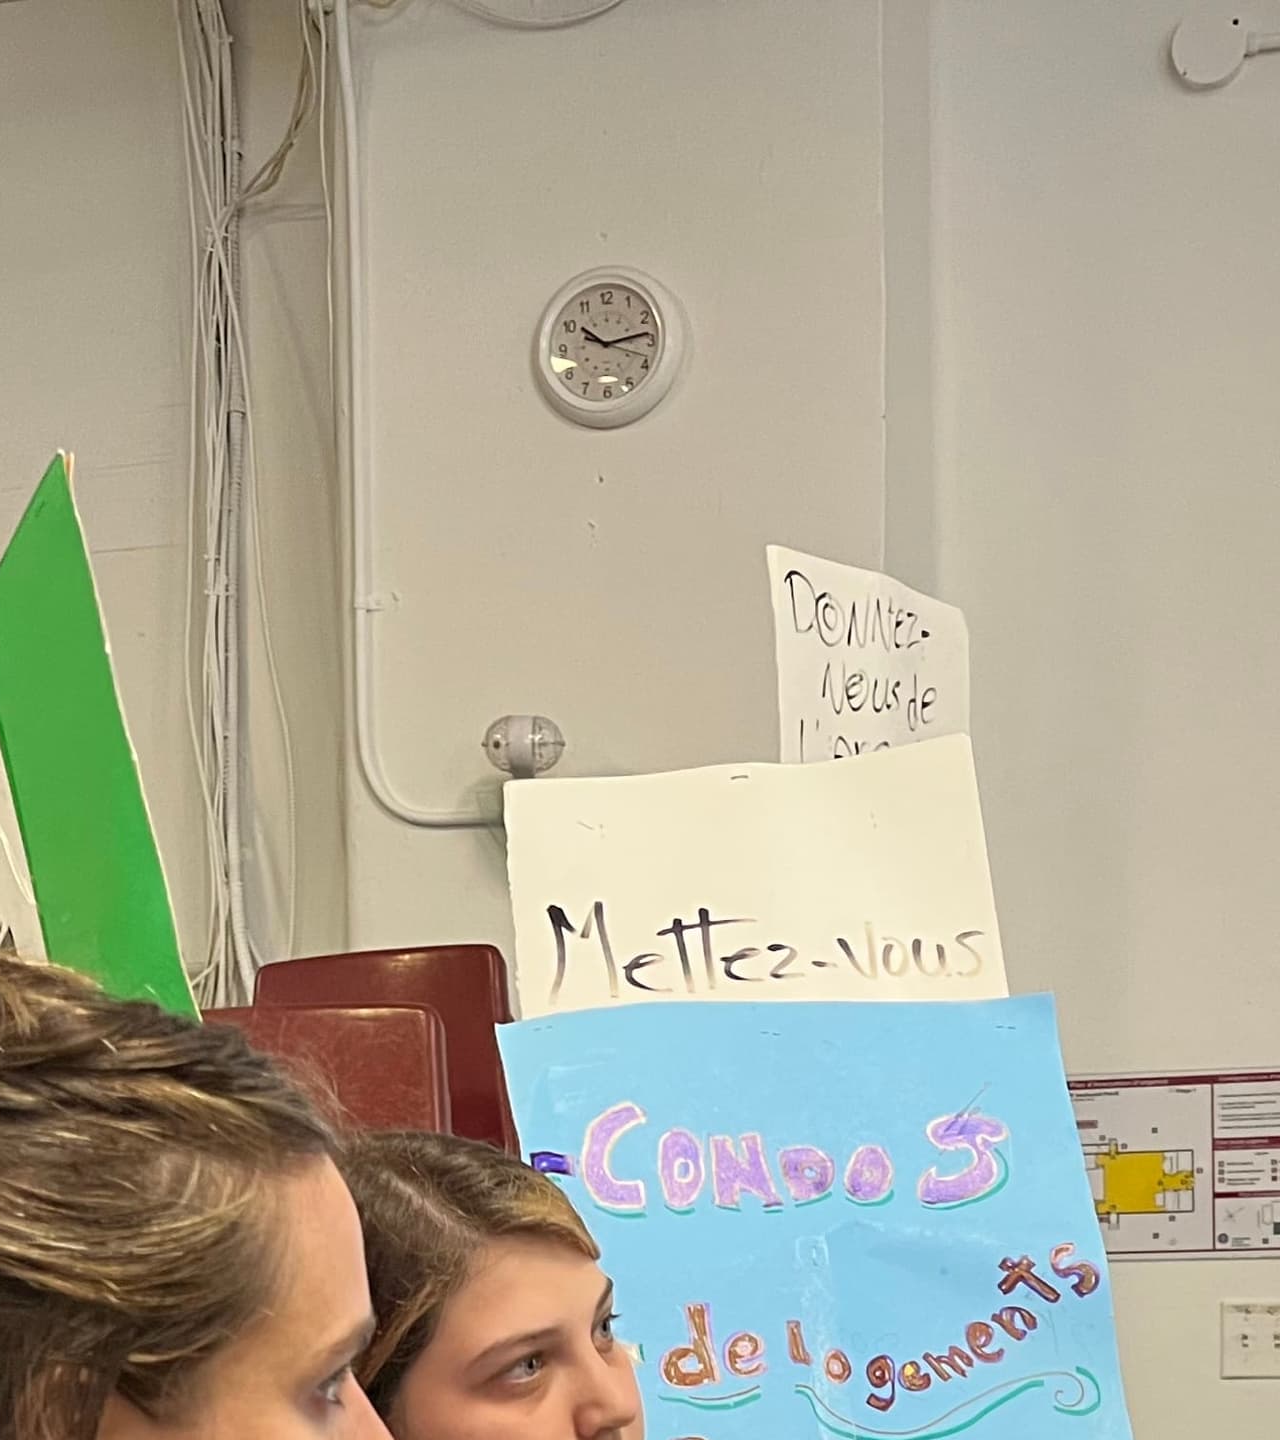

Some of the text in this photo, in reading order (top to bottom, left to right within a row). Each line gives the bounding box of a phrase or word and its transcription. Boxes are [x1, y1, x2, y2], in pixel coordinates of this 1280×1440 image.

[599, 290, 614, 305] 12
[625, 295, 632, 309] 1
[579, 300, 591, 313] 11
[639, 310, 650, 325] 2
[562, 319, 577, 334] 10
[646, 333, 656, 347] 3
[558, 343, 568, 358] 9
[639, 358, 649, 372] 4
[580, 382, 590, 396] 7
[603, 386, 613, 399] 6
[906, 672, 938, 733] de
[658, 1242, 1101, 1412] de logements
